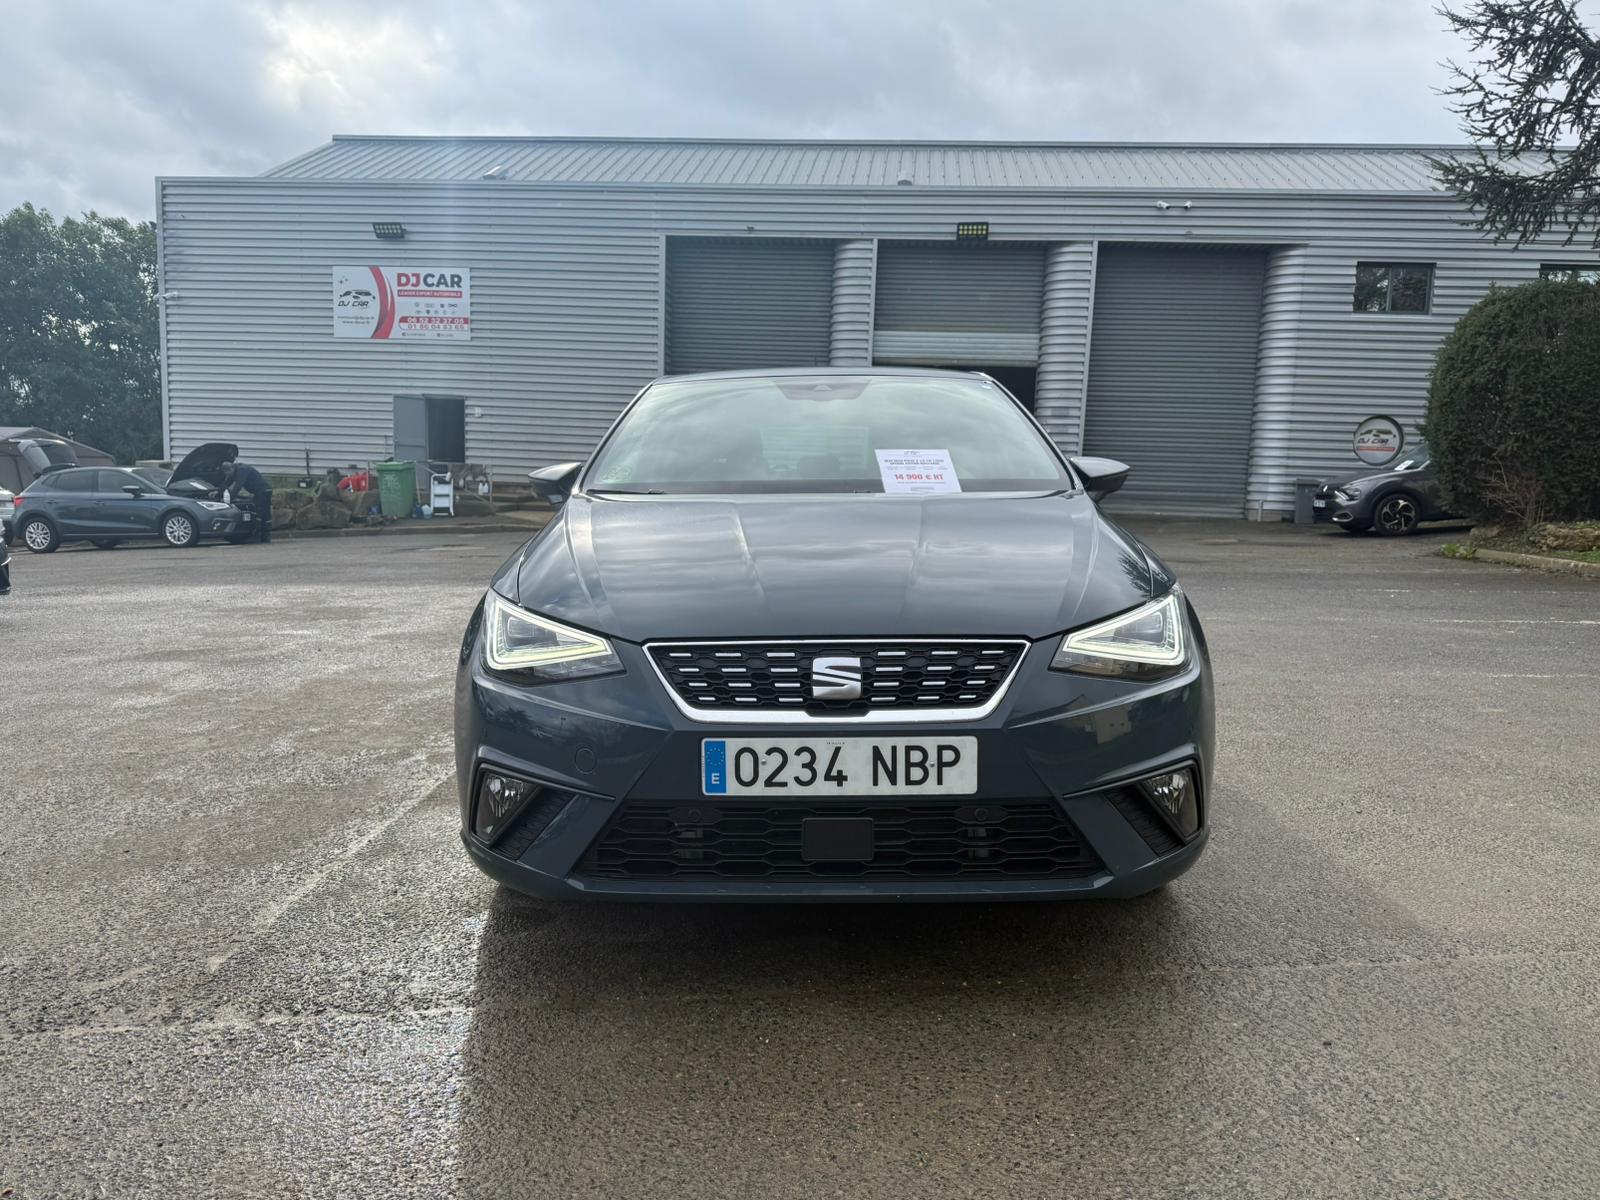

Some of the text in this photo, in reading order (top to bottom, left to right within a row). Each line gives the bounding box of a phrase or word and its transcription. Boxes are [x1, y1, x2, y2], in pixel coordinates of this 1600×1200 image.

[397, 273, 462, 288] DJ CAR
[711, 745, 961, 788] E 0234 NBP
